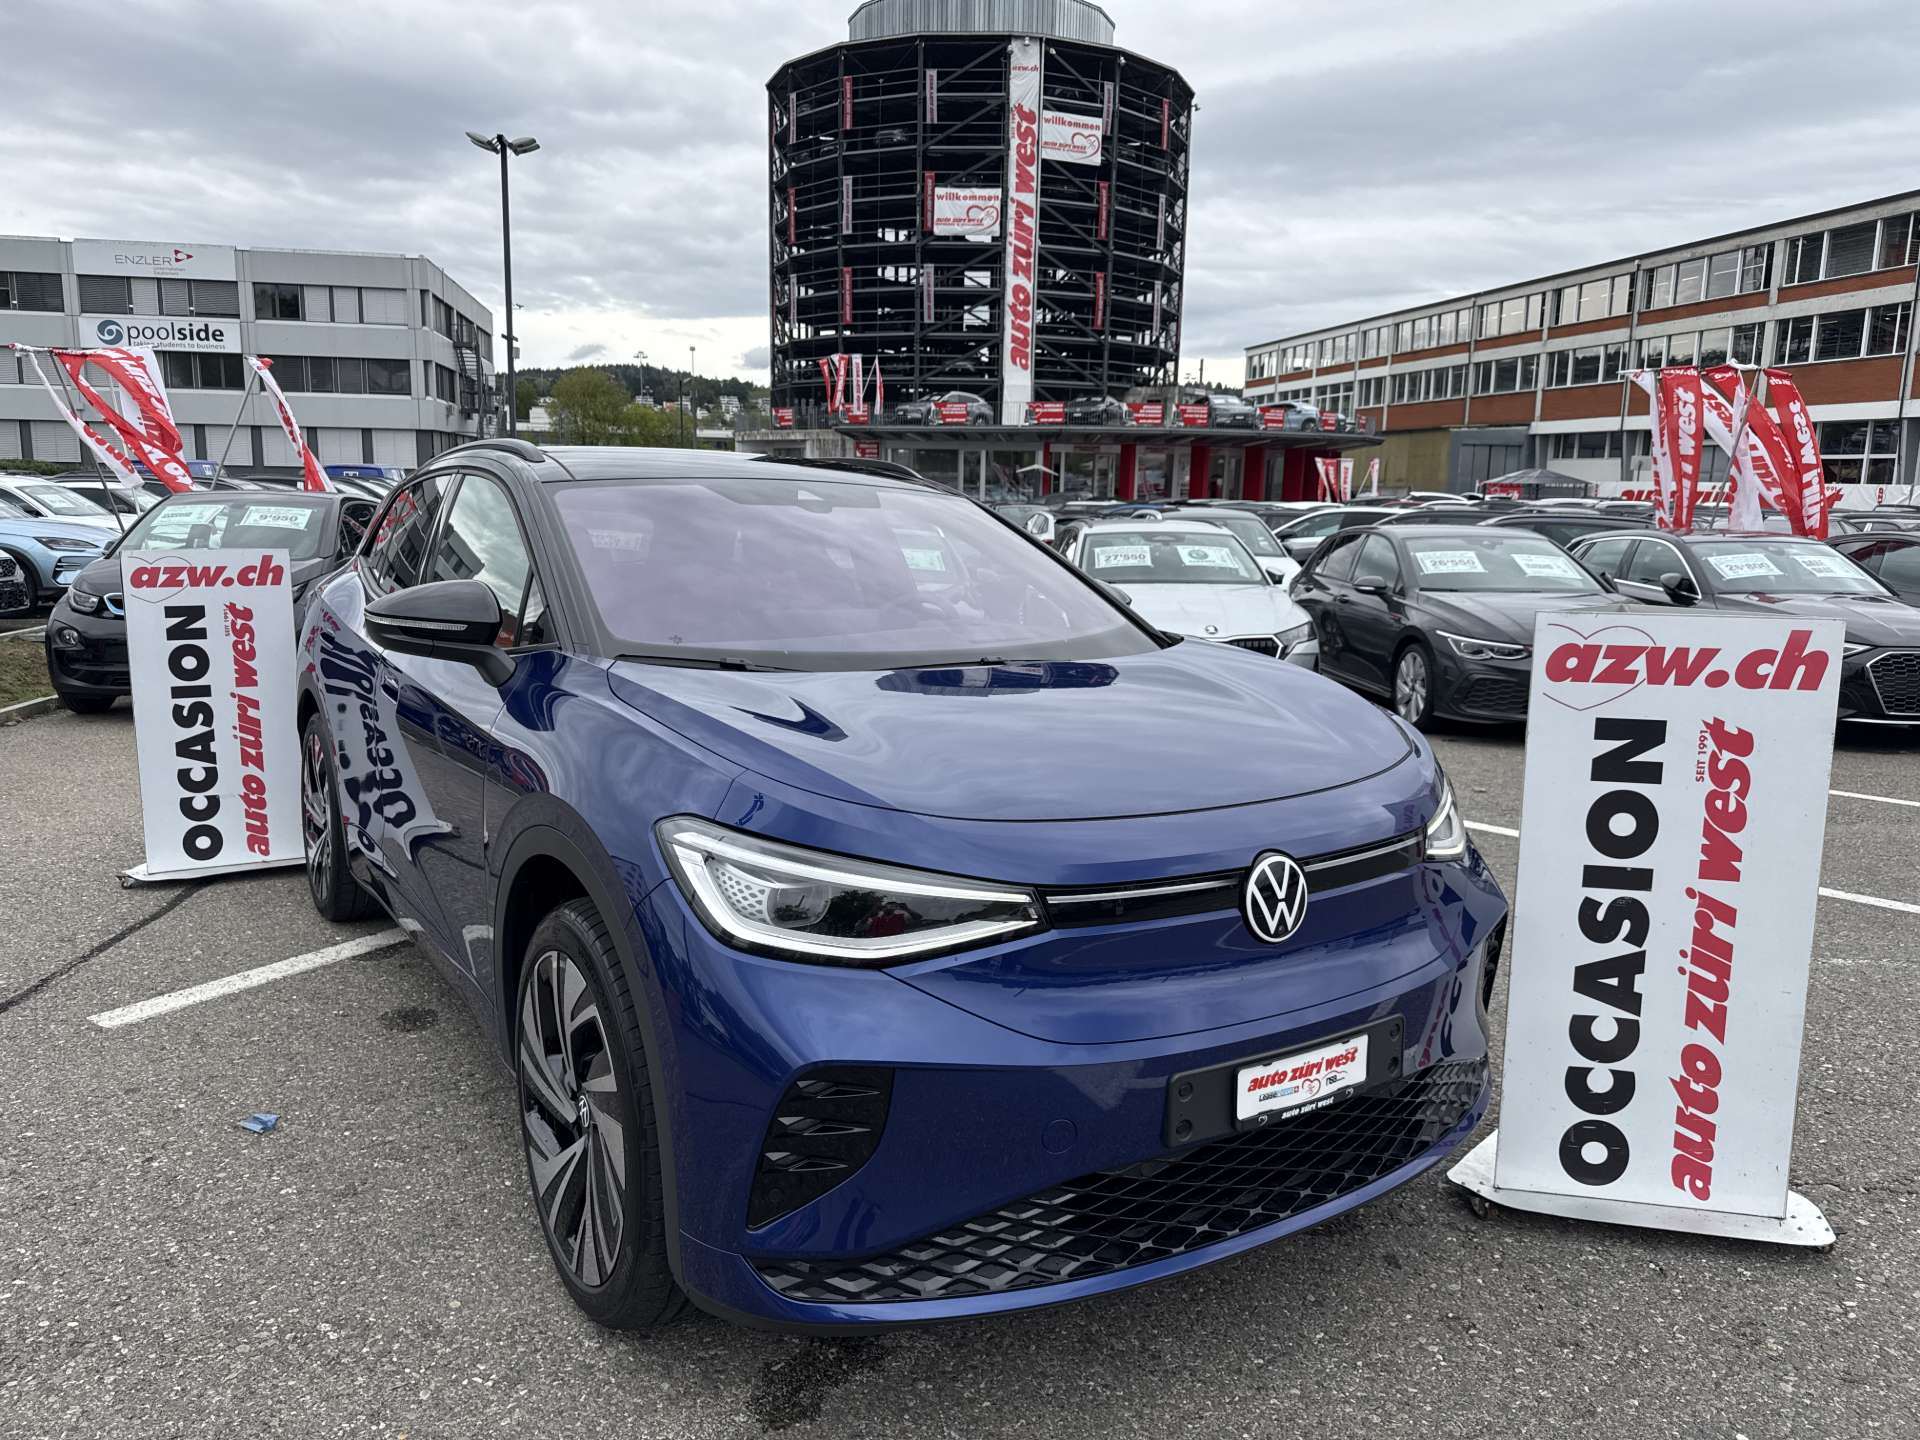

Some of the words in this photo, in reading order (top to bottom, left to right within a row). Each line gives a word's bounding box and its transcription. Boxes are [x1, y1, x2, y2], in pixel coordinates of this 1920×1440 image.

[1014, 102, 1037, 194] west
[1043, 115, 1101, 131] willkommen
[936, 192, 1000, 202] willkommen
[114, 254, 172, 267] ENZLER
[1008, 197, 1035, 282] züri
[127, 322, 225, 347] poolside
[196, 342, 226, 351] business
[1010, 283, 1033, 371] auto
[1678, 386, 1696, 456] west
[130, 555, 284, 589] azw.ch
[223, 601, 259, 688] west
[1545, 630, 1829, 691] azw.ch
[164, 605, 224, 861] OCCASION
[229, 691, 265, 773] züri
[1697, 729, 1710, 758] 1991
[1695, 758, 1706, 783] SEIT
[1697, 716, 1755, 883] west
[238, 773, 271, 857] auto
[1558, 717, 1668, 1187] OCCASION
[1677, 886, 1738, 1046] züri
[1248, 1070, 1288, 1093] auto
[1288, 1057, 1325, 1083] züri
[1325, 1047, 1359, 1072] west
[1281, 1107, 1300, 1119] auto
[1667, 1043, 1723, 1202] auto
